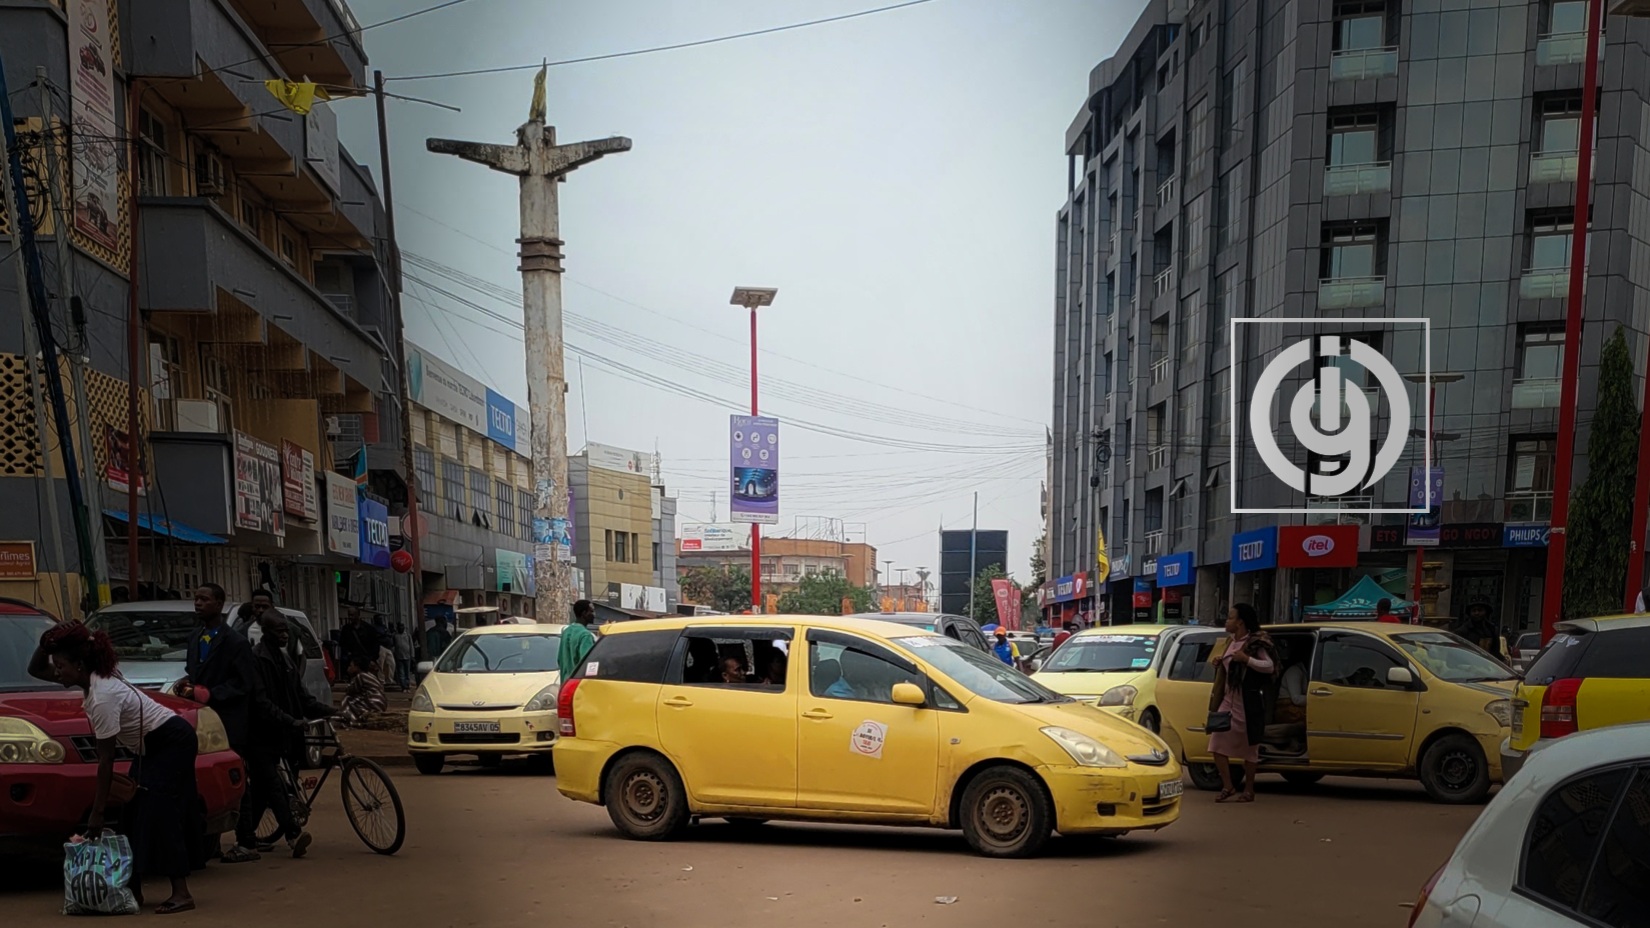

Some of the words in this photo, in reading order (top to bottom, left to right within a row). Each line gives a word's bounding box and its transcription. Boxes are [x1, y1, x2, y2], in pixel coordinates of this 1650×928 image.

[366, 518, 389, 547] TECNO
[1376, 530, 1398, 543] ETS
[1509, 529, 1541, 542] PHILIPS
[1238, 540, 1265, 562] TECNO
[1308, 539, 1329, 551] itel
[1163, 562, 1181, 578] TECNO
[71, 870, 109, 907] AAA
